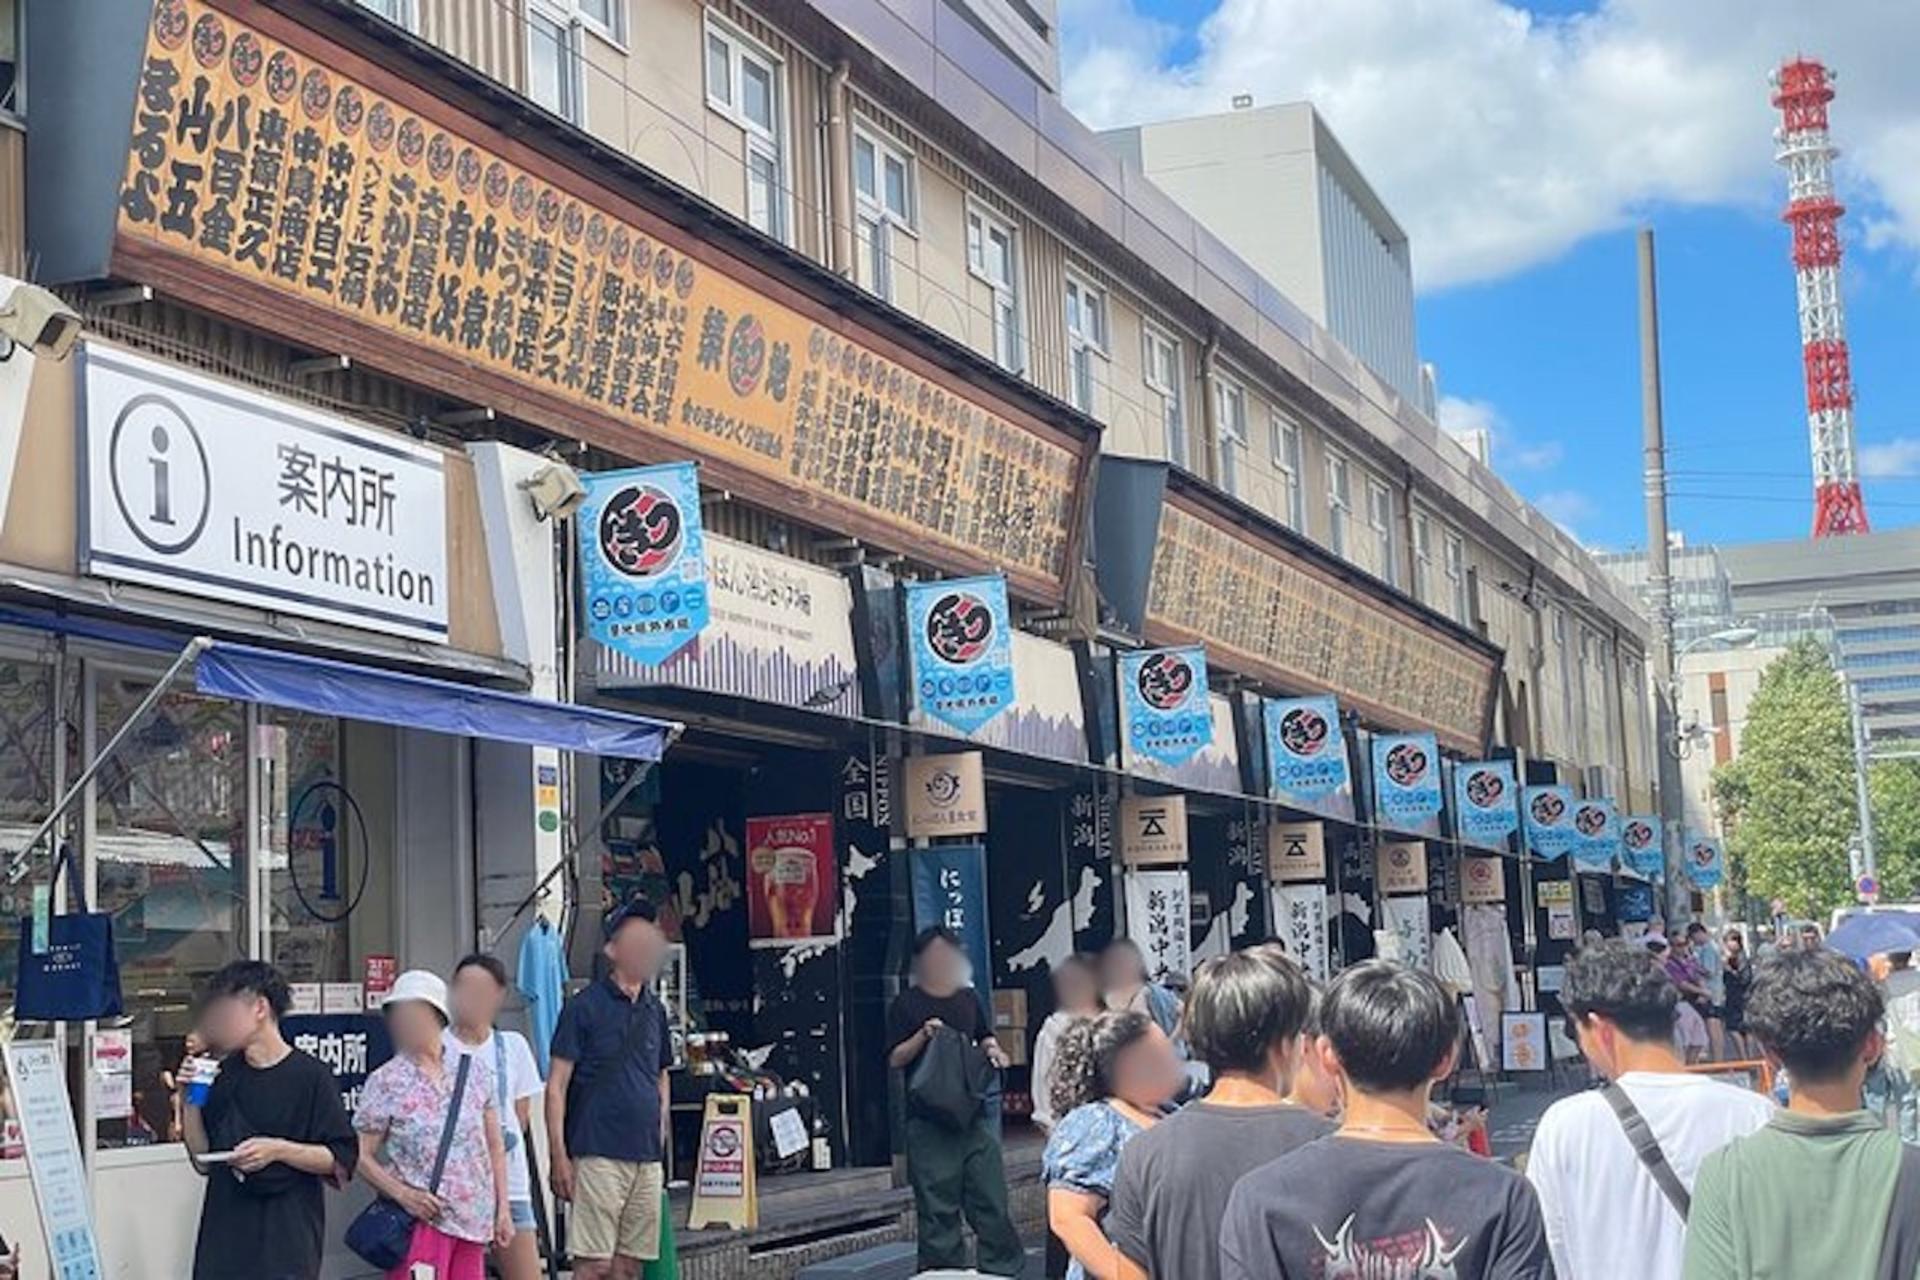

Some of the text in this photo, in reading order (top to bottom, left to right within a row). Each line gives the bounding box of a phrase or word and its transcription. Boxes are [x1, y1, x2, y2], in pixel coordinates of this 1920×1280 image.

[121, 57, 180, 223] まるよ
[160, 75, 215, 240] 山五
[199, 94, 250, 256] 八百金
[431, 200, 473, 342] 有次
[277, 443, 396, 536] 案内所
[234, 517, 434, 606] Information
[841, 755, 870, 820] 全国
[940, 867, 965, 936] にっぽ
[294, 1033, 367, 1077] 案内所
